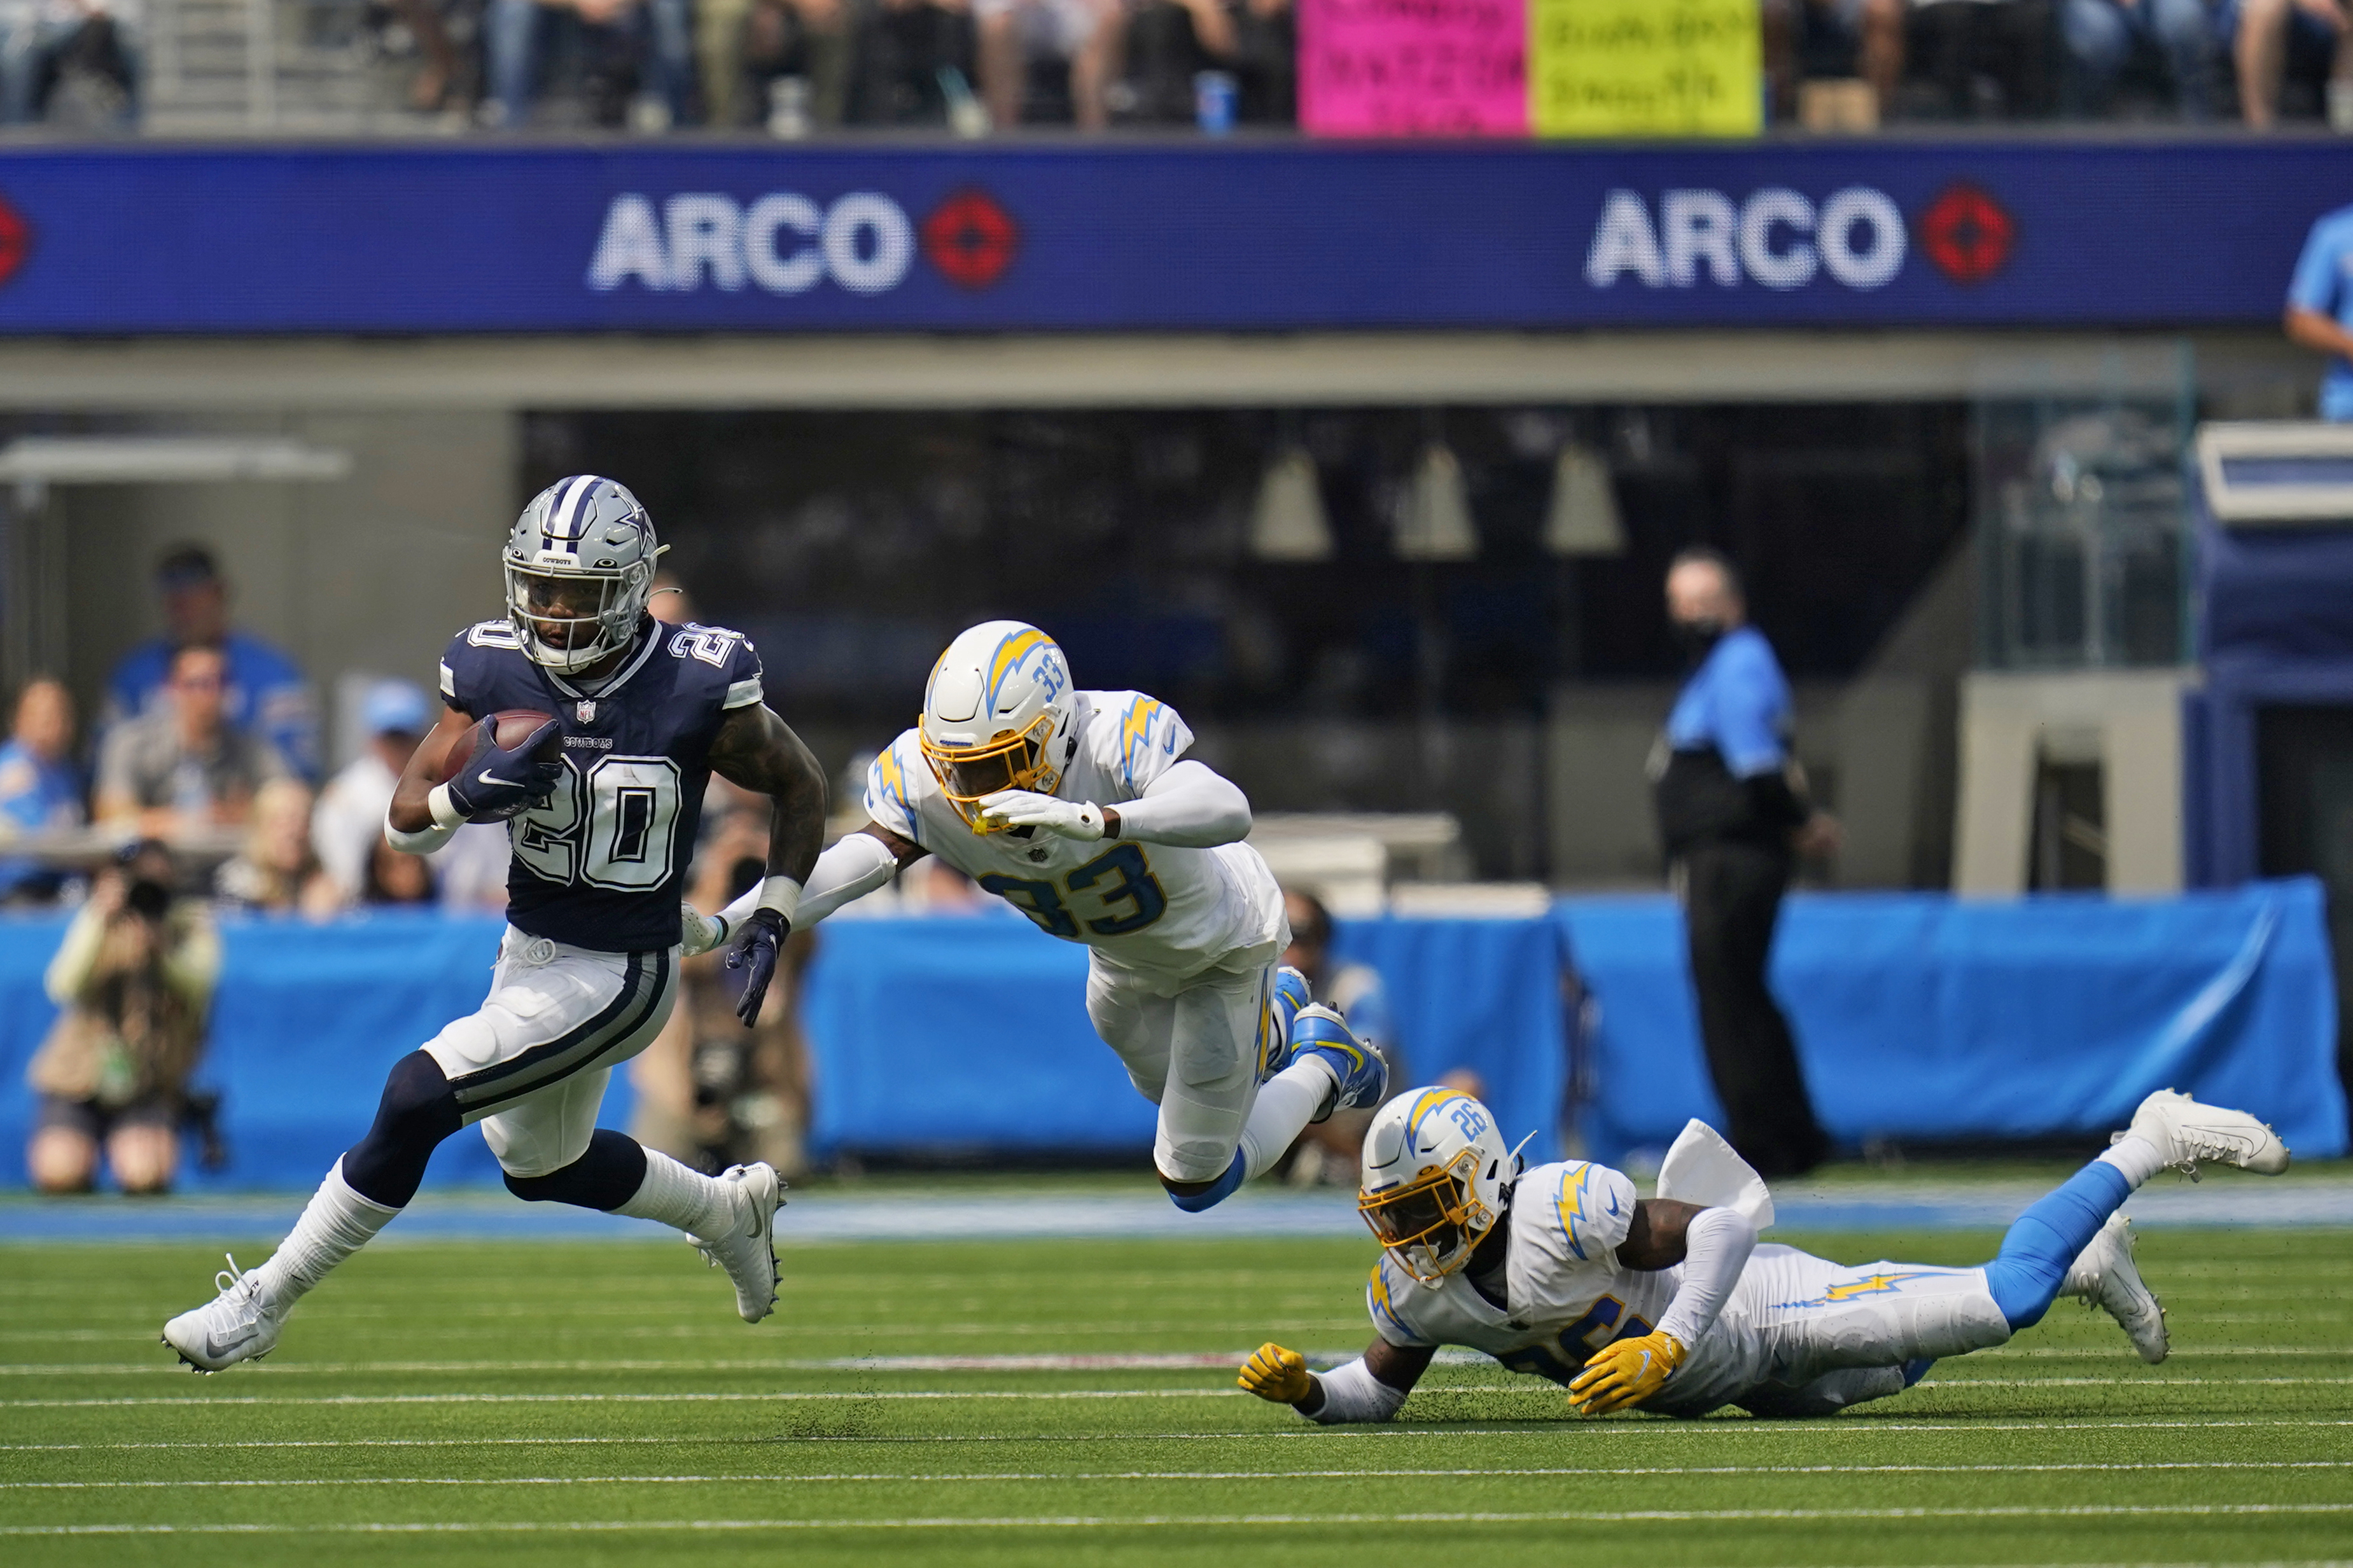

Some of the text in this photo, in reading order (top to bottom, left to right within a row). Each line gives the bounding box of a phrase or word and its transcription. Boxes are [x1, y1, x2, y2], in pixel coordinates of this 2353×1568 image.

[587, 190, 915, 296] ARCO
[1581, 186, 1908, 290] ARCO
[1033, 654, 1065, 703] 33
[580, 710, 592, 719] NFL
[564, 736, 613, 749] COWBOYS
[510, 753, 682, 892] 20
[1451, 1102, 1488, 1142] 26
